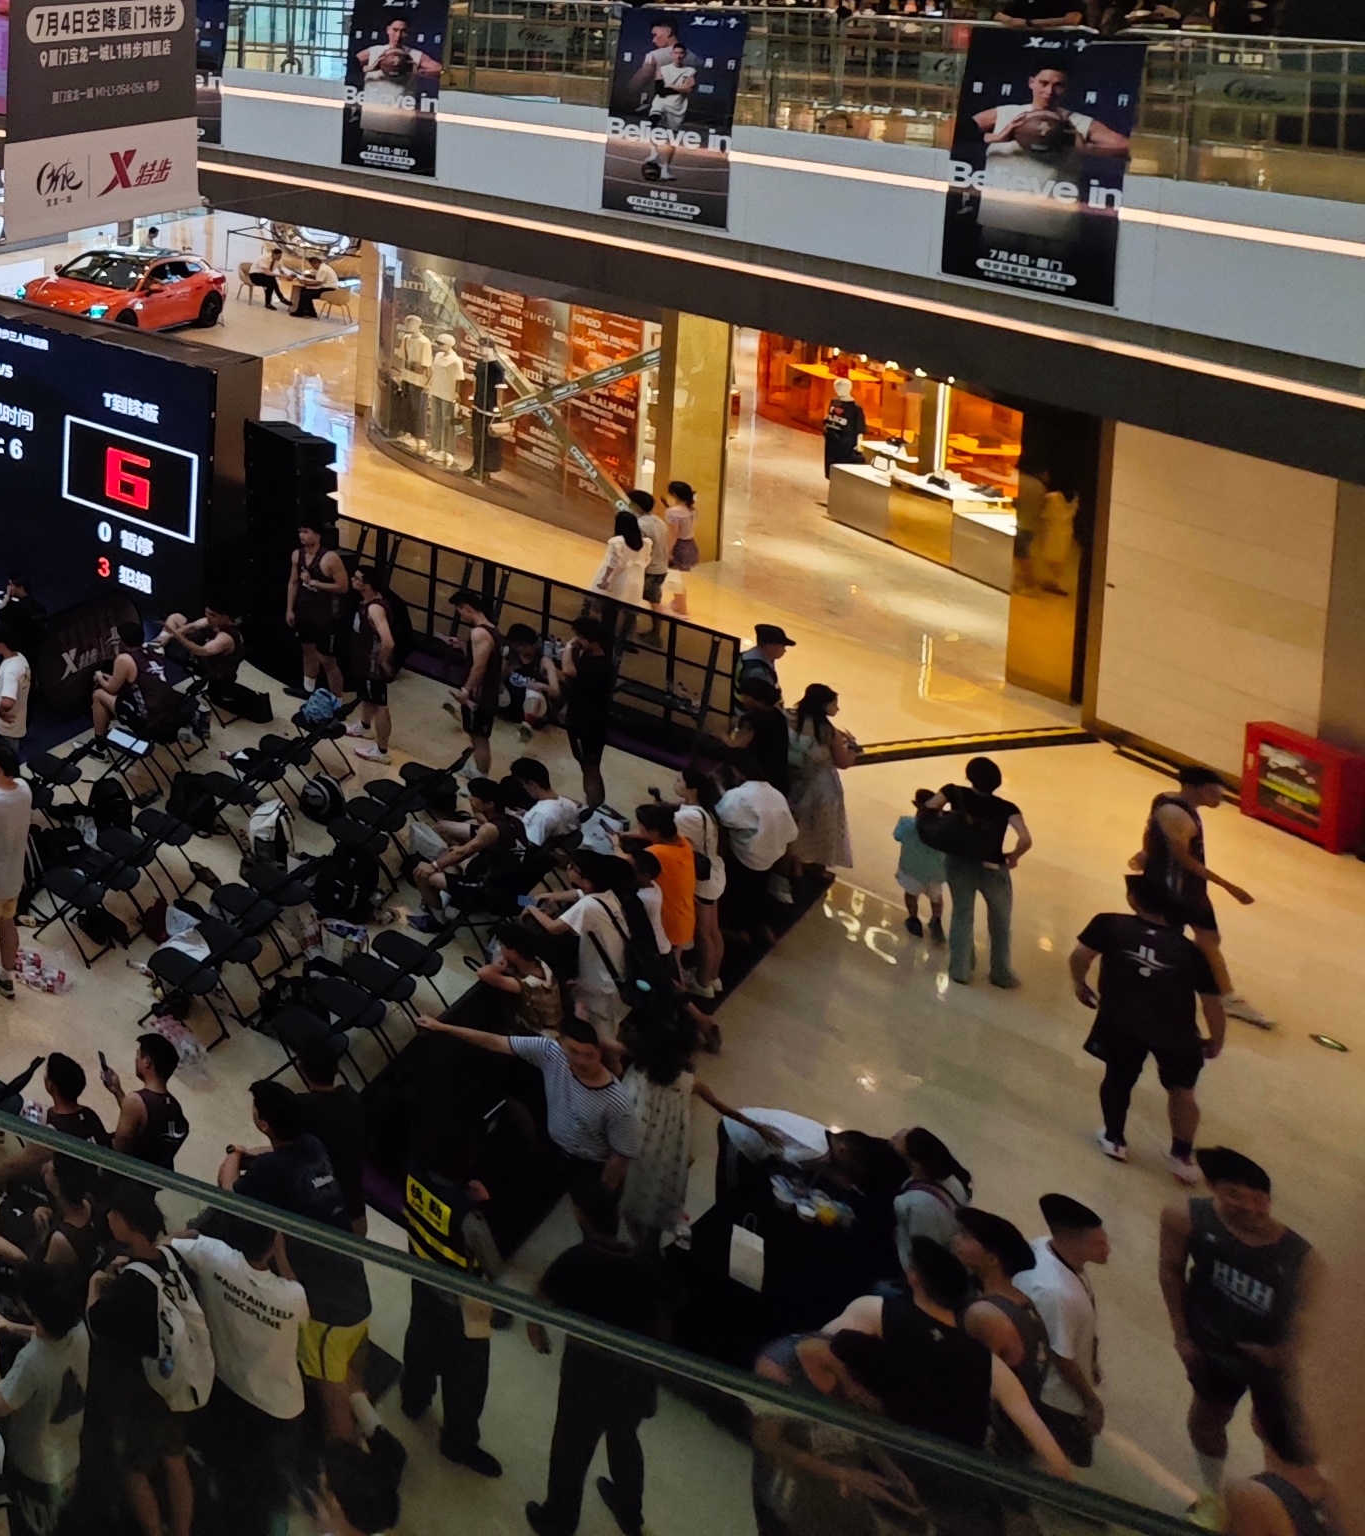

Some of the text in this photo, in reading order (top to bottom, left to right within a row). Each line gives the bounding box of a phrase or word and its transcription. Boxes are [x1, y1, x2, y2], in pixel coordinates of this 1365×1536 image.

[35, 4, 177, 37] 7月4日空降厦门特步
[421, 92, 439, 113] in
[608, 116, 732, 154] Believe in
[1087, 178, 1122, 212] in
[105, 446, 151, 511] 6
[97, 521, 154, 557] 0 暂停
[97, 556, 152, 595] 3 犯规
[213, 1271, 295, 1321] MAINTAIN SELF
[223, 1292, 282, 1331] DISCIPLINE
